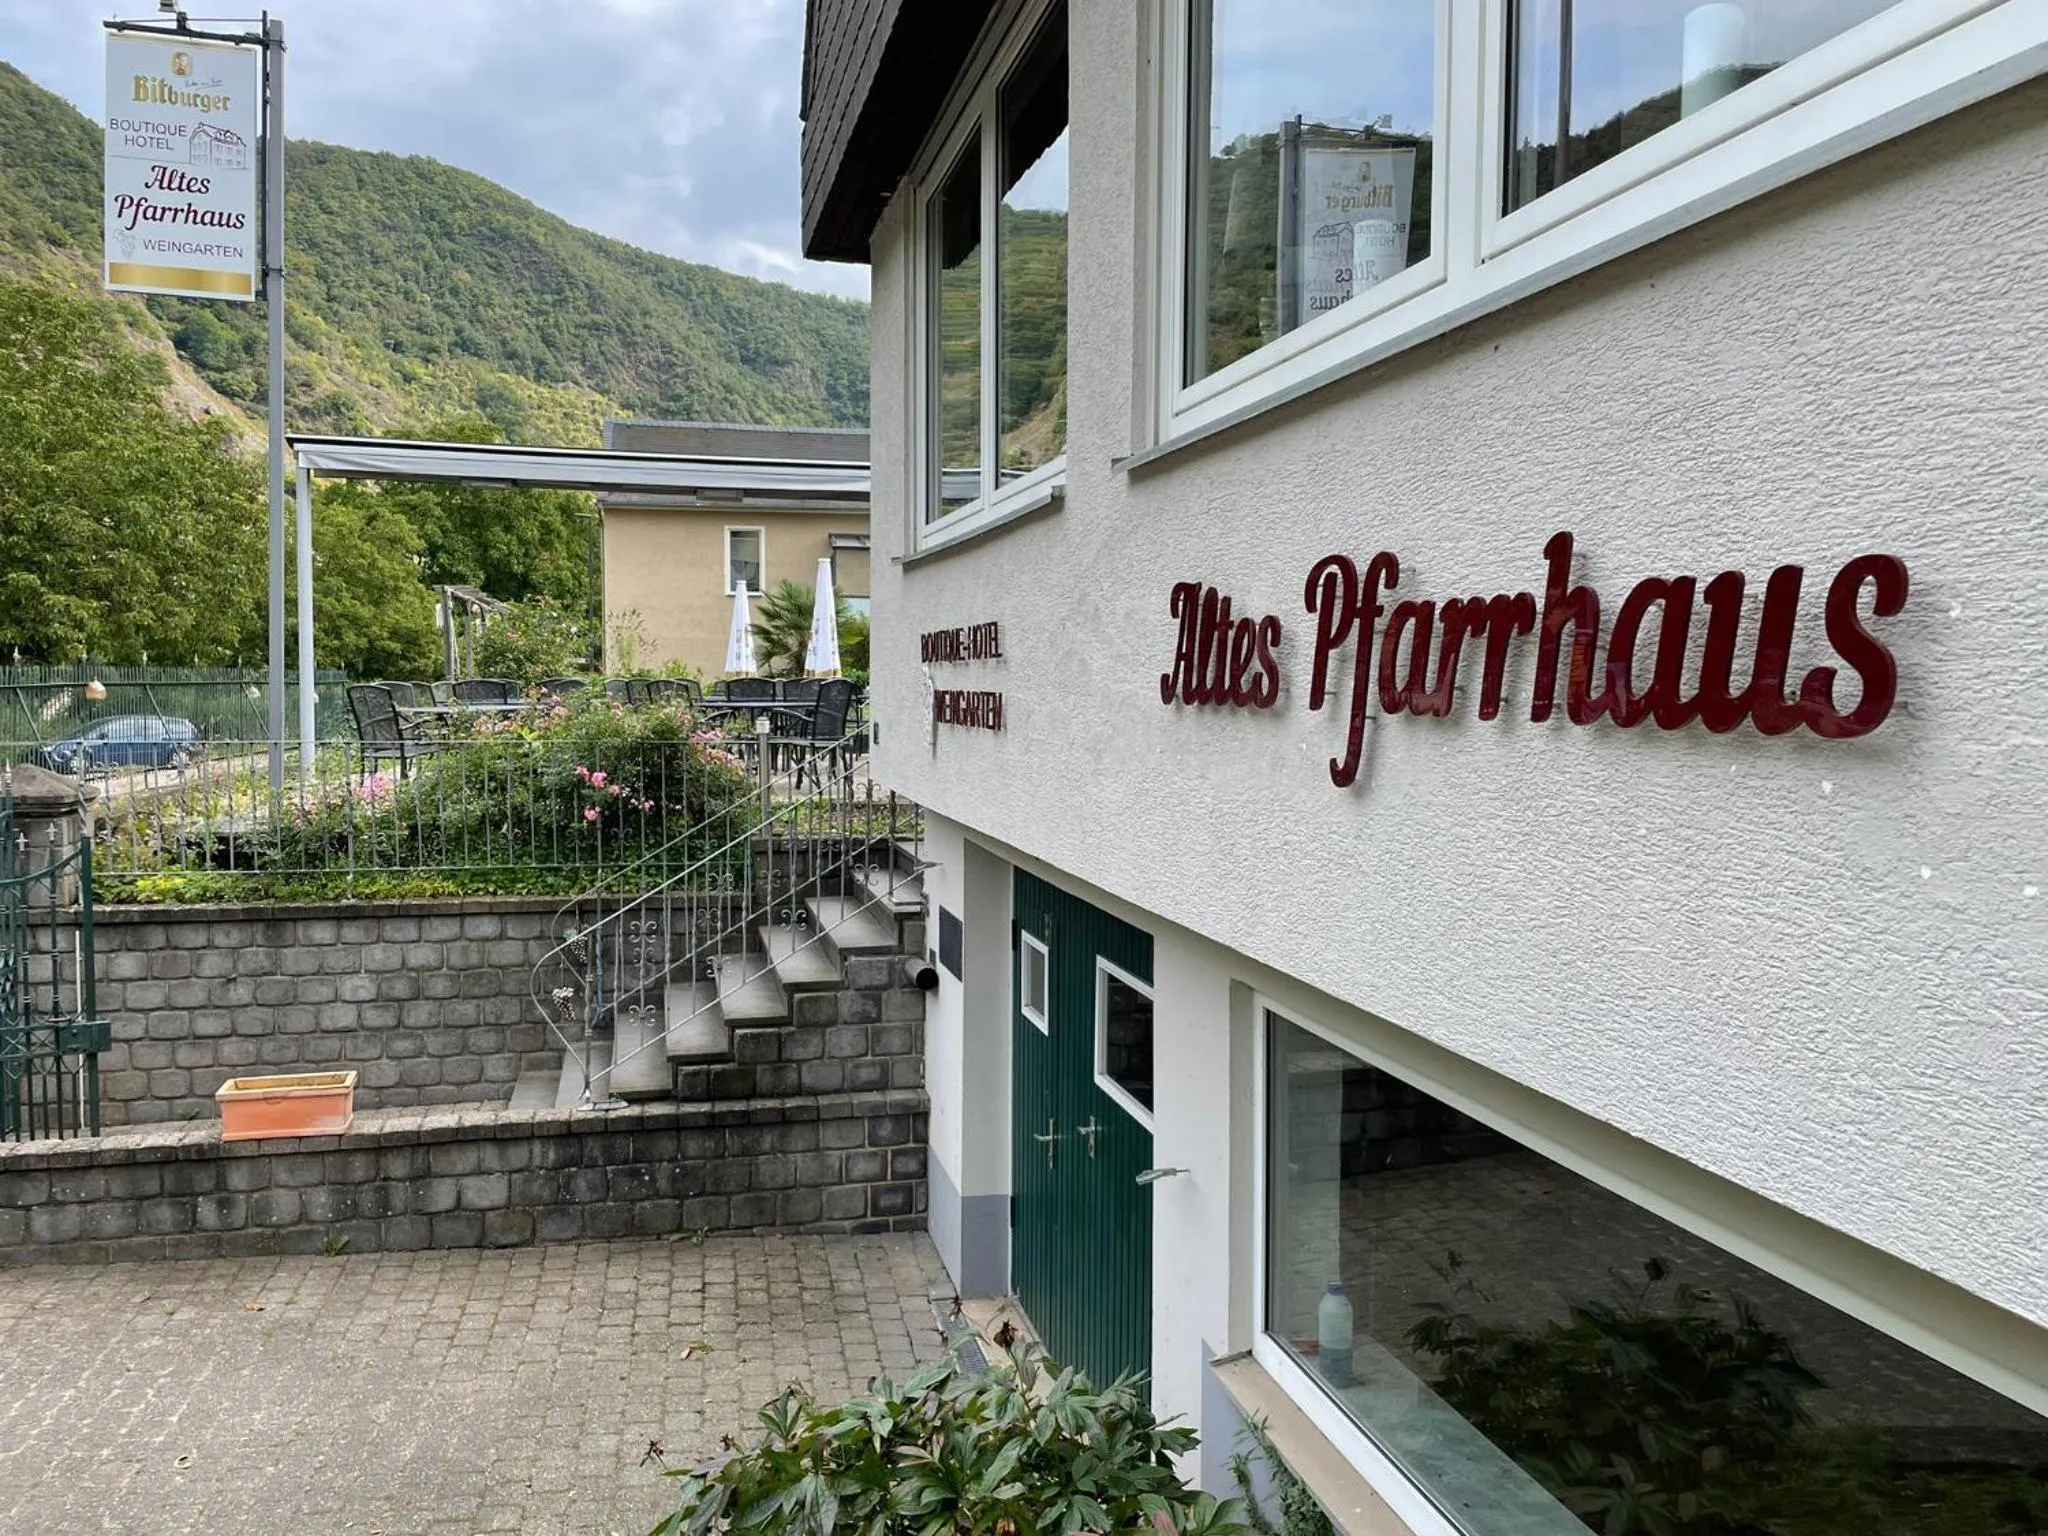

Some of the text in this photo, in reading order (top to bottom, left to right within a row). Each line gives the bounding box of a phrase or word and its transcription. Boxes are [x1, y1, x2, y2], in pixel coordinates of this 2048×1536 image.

[132, 76, 230, 112] Bitburger
[109, 118, 188, 138] BOUTIQUE
[125, 134, 174, 151] HOTEL
[144, 165, 211, 194] Altes
[114, 194, 245, 230] Pfarrhaus
[143, 239, 243, 258] WEINGARTEN
[1160, 531, 1909, 788] Altes Pfarrhaus
[934, 690, 1002, 731] WEINGARTEN
